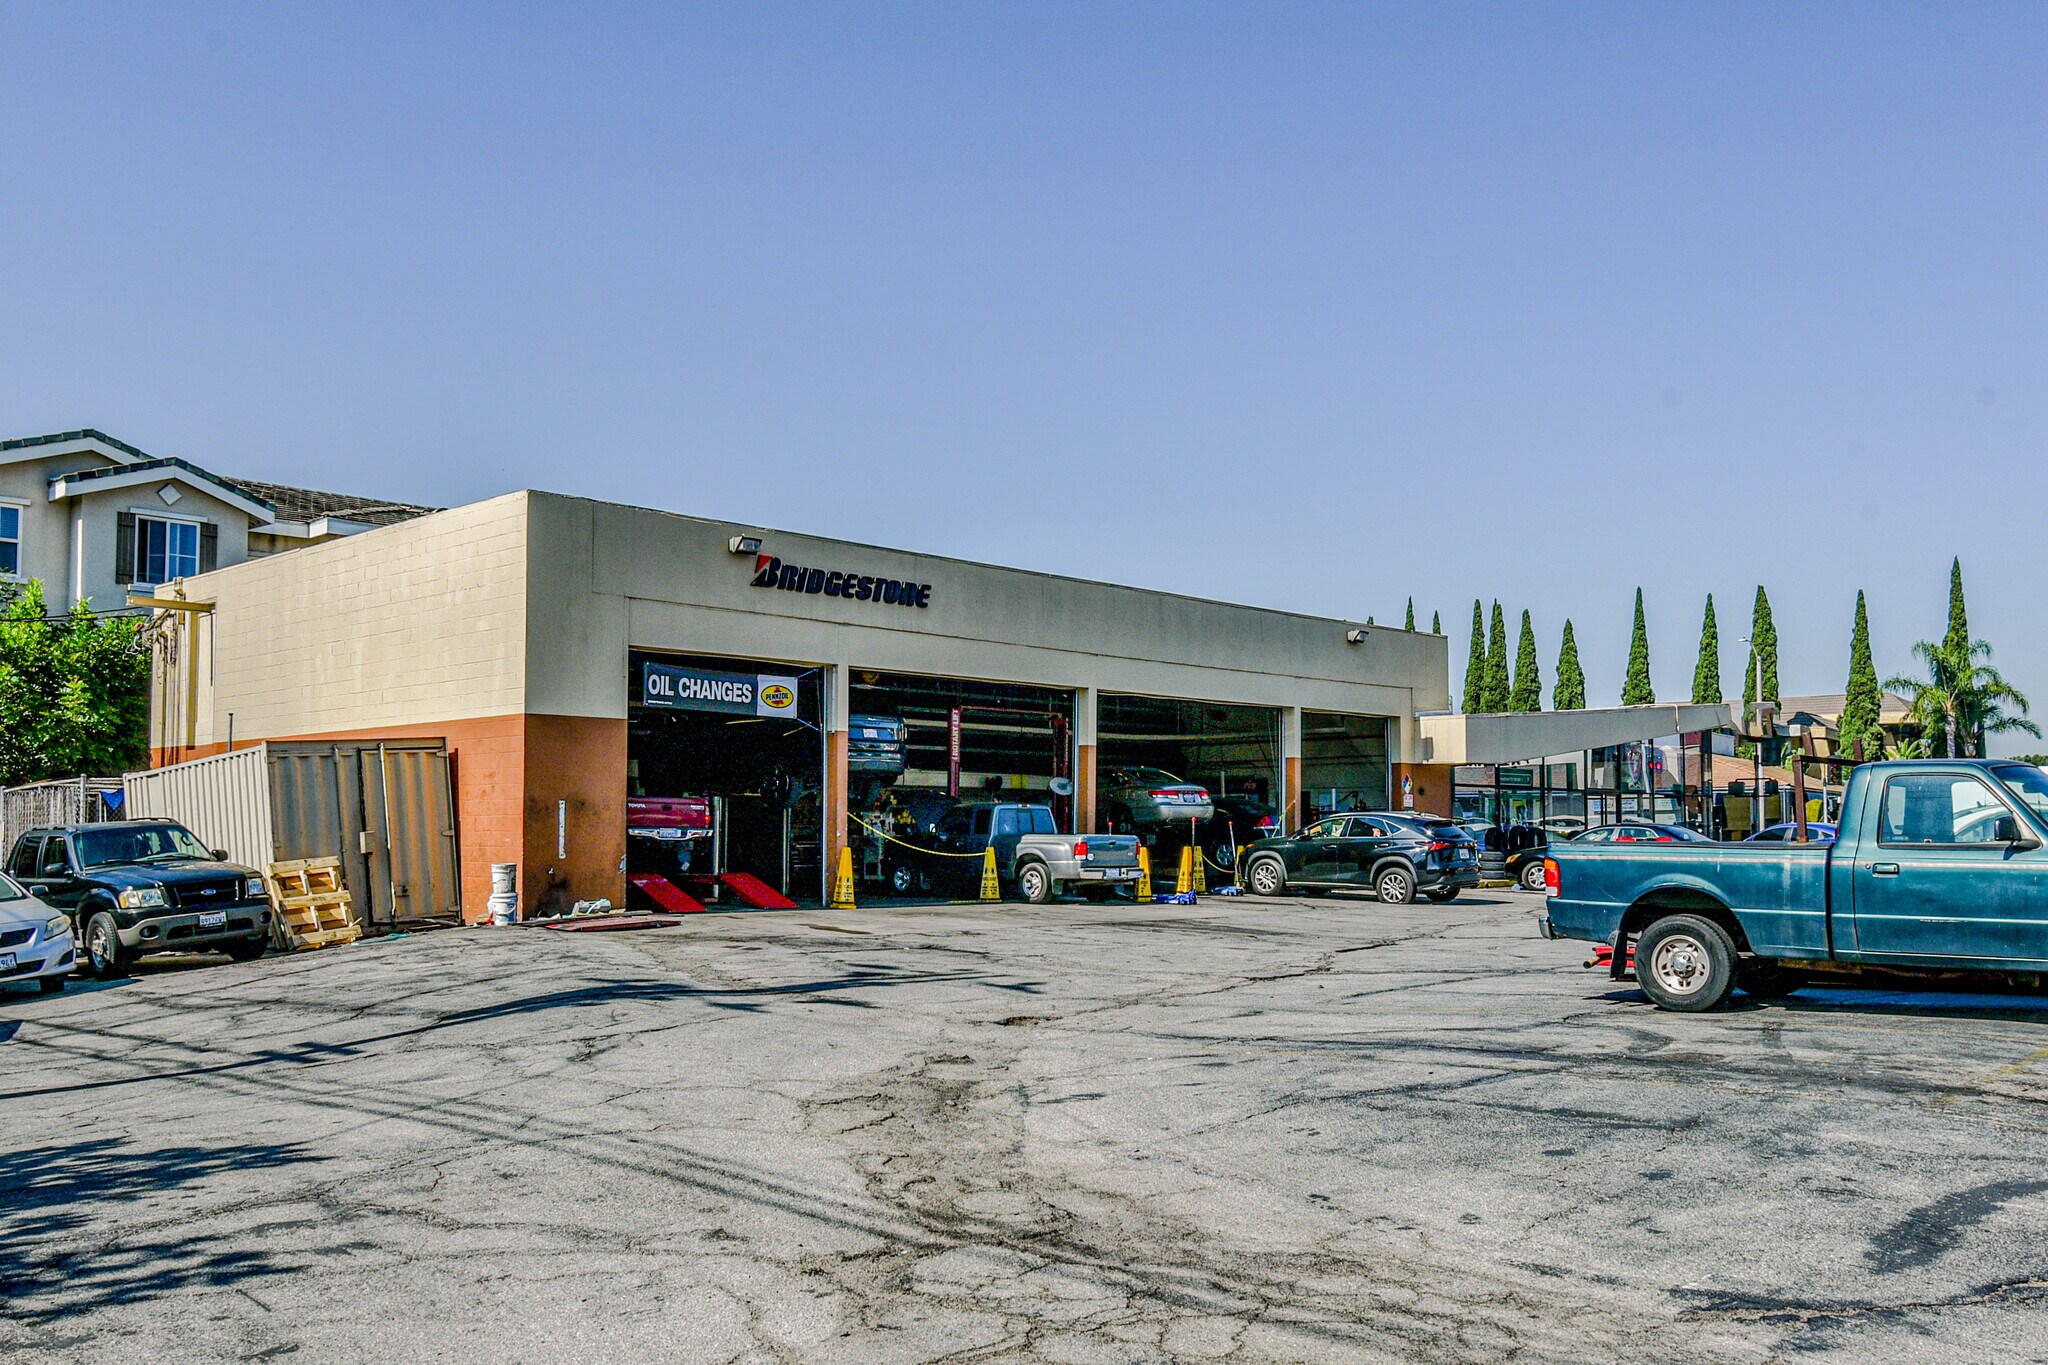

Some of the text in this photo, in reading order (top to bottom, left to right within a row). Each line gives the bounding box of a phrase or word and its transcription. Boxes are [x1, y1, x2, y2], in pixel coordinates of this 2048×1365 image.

[750, 553, 932, 608] BRIDGESTONE
[648, 674, 752, 704] OIL CHANGES
[765, 692, 789, 700] PENNZOIL
[951, 708, 959, 725] LIFT
